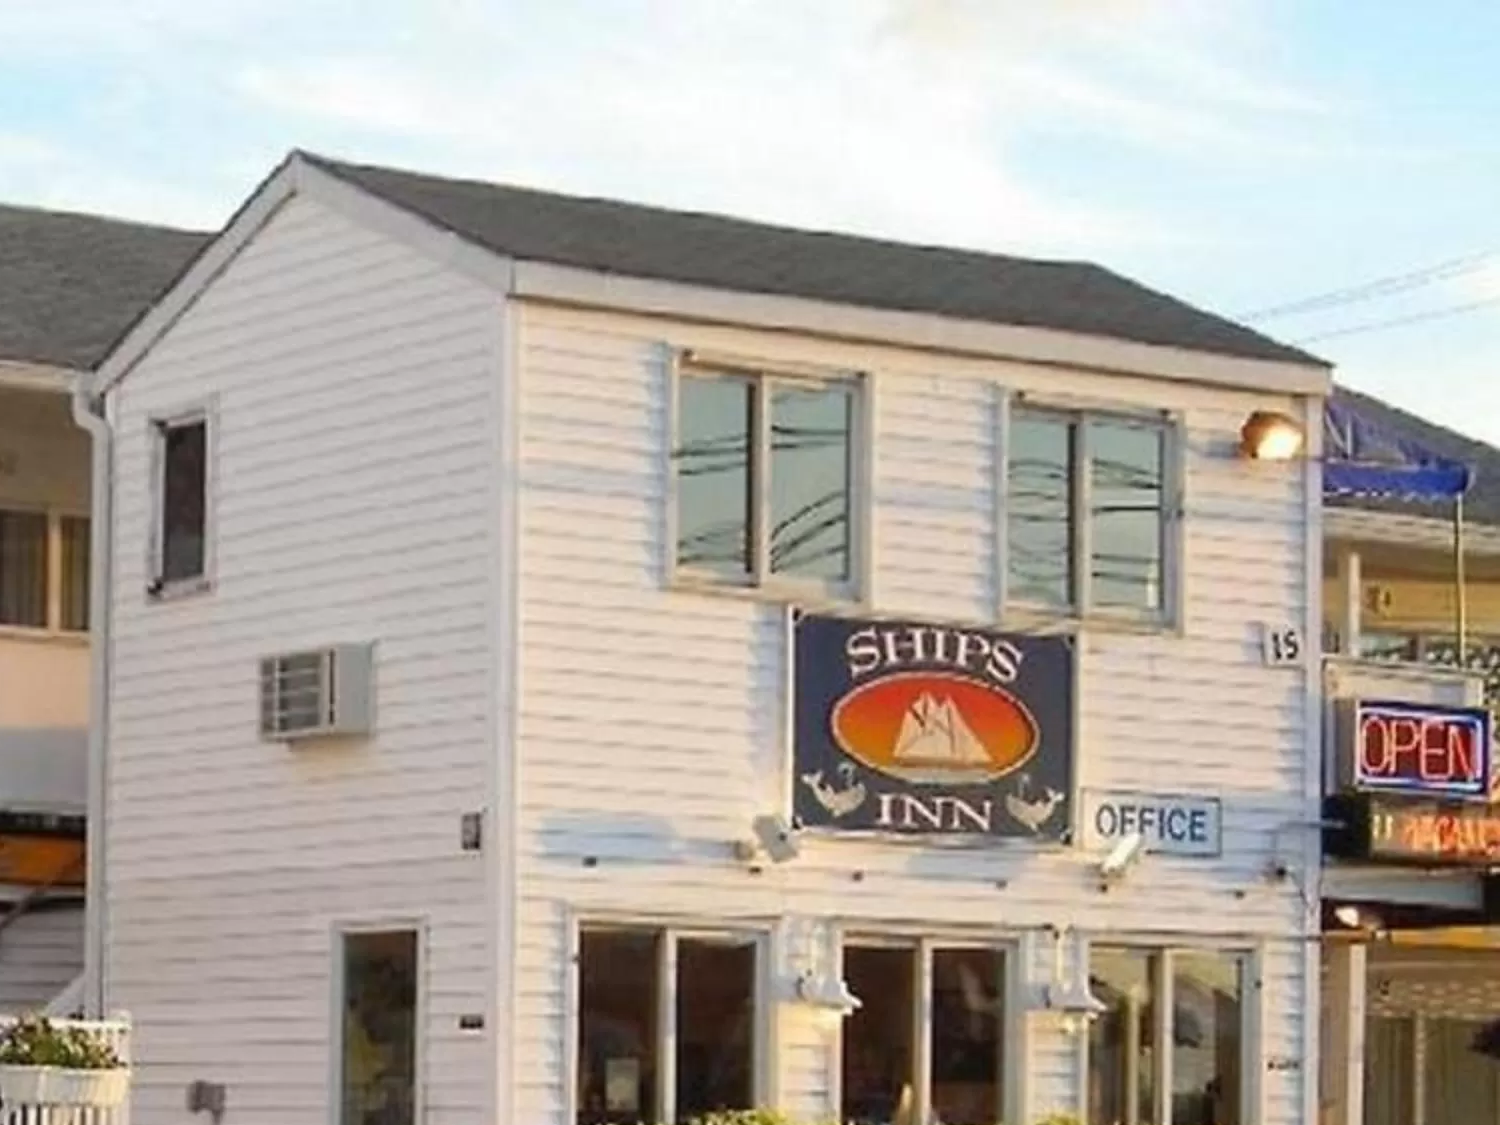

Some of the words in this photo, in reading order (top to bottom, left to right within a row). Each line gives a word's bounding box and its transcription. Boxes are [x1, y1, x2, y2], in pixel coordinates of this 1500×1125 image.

[846, 624, 1025, 683] SHIPS
[1361, 715, 1478, 781] OPEN
[876, 793, 994, 832] INN
[1094, 804, 1208, 842] OFFICE
